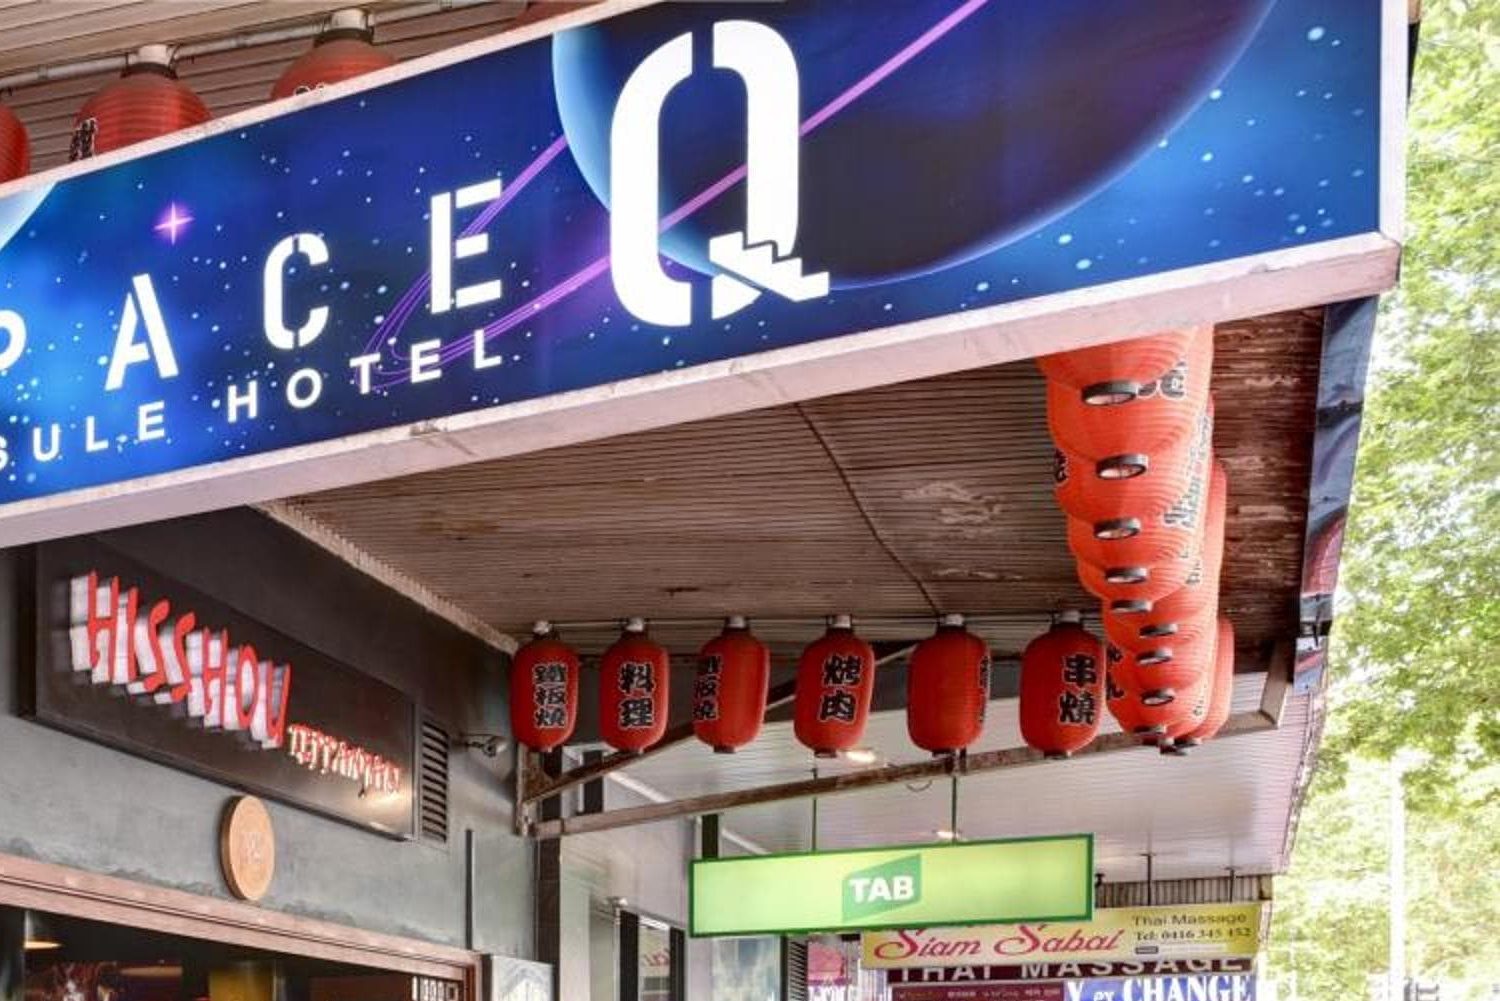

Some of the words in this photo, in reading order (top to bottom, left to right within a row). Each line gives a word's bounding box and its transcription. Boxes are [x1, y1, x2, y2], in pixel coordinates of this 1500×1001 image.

[610, 19, 830, 327] Q
[227, 329, 502, 423] HOTEL
[72, 570, 291, 749] HISSHOU
[850, 875, 914, 903] TAB
[1133, 914, 1167, 926] Thai
[1172, 912, 1247, 926] Massage
[873, 927, 980, 960] Siam
